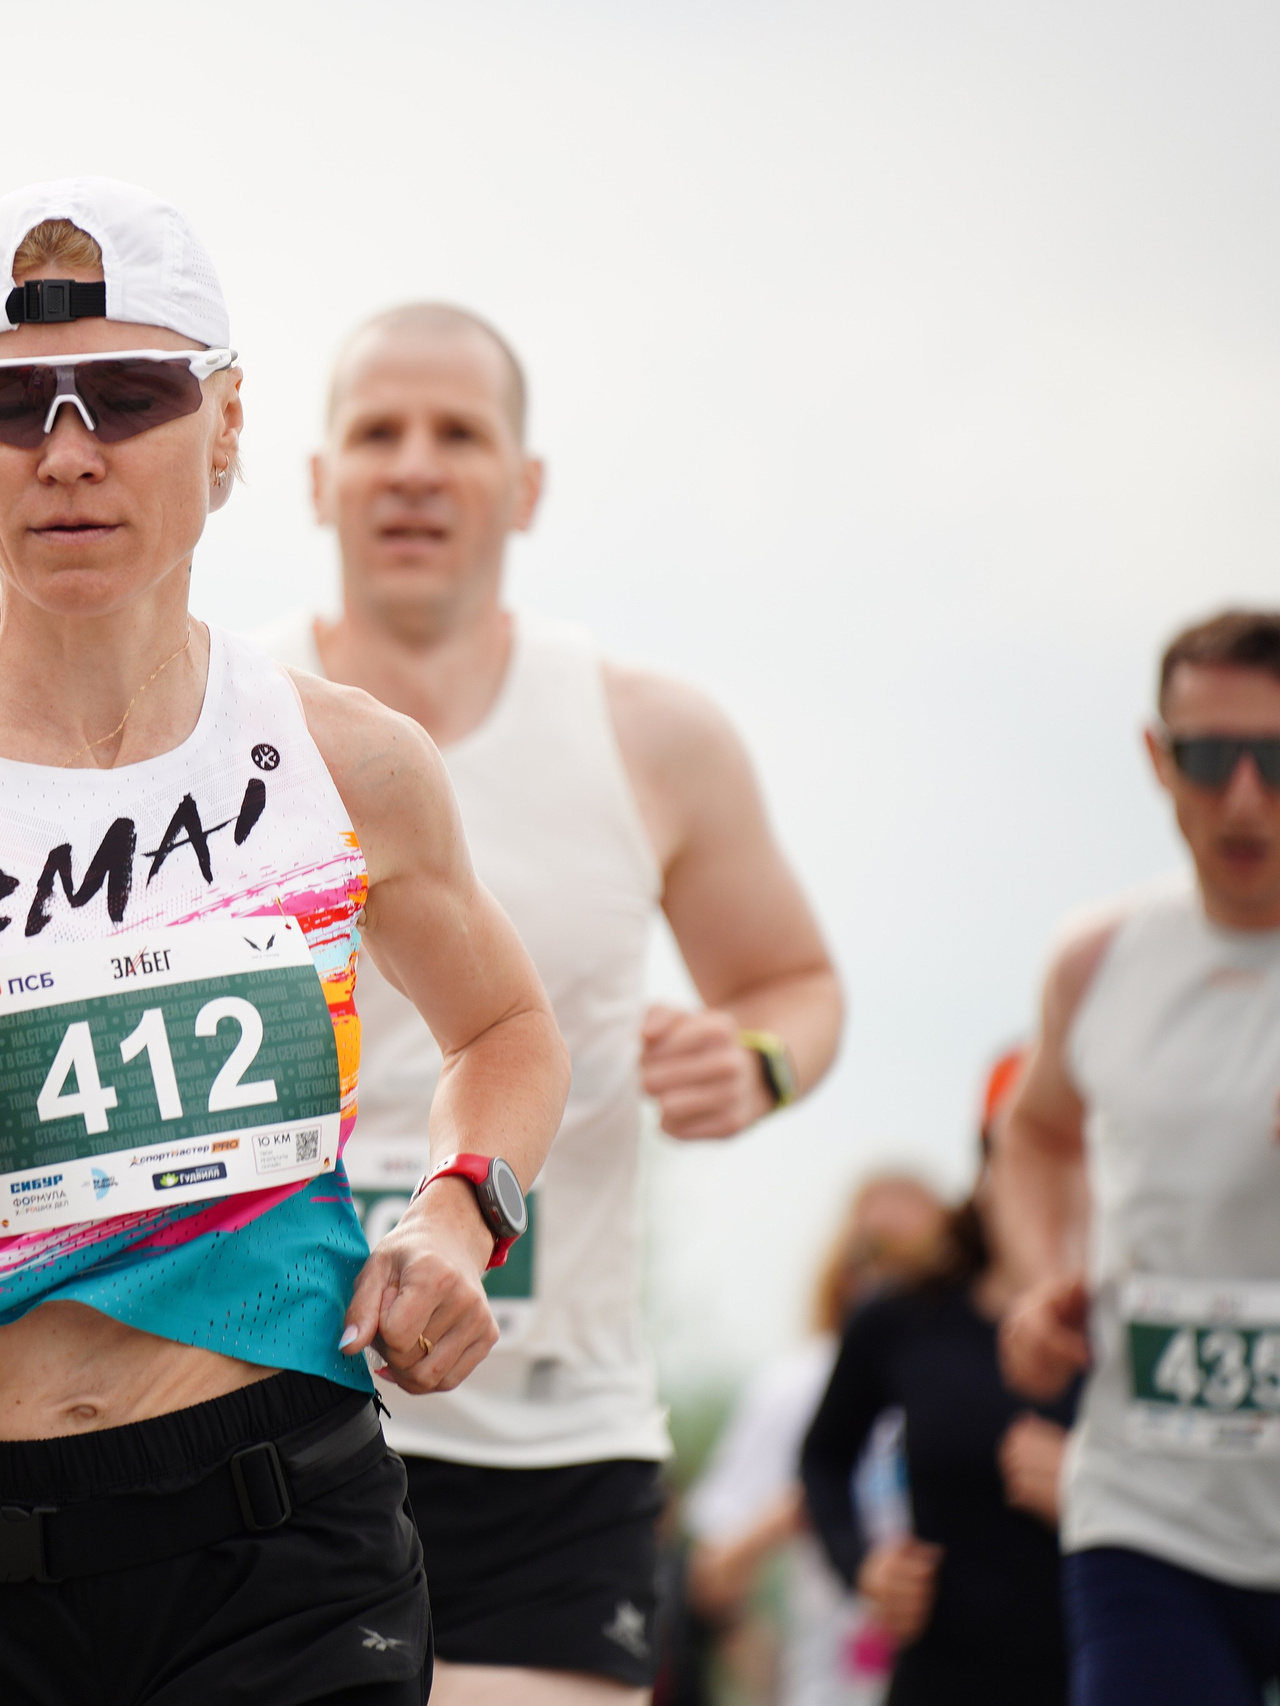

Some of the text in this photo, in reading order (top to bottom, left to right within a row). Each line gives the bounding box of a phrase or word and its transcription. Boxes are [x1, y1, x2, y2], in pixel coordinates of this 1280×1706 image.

[7, 971, 55, 995] ПСБ
[36, 995, 279, 1136] 412
[10, 1173, 63, 1194] СИБУР
[13, 1190, 67, 1208] ФОРМУЛА
